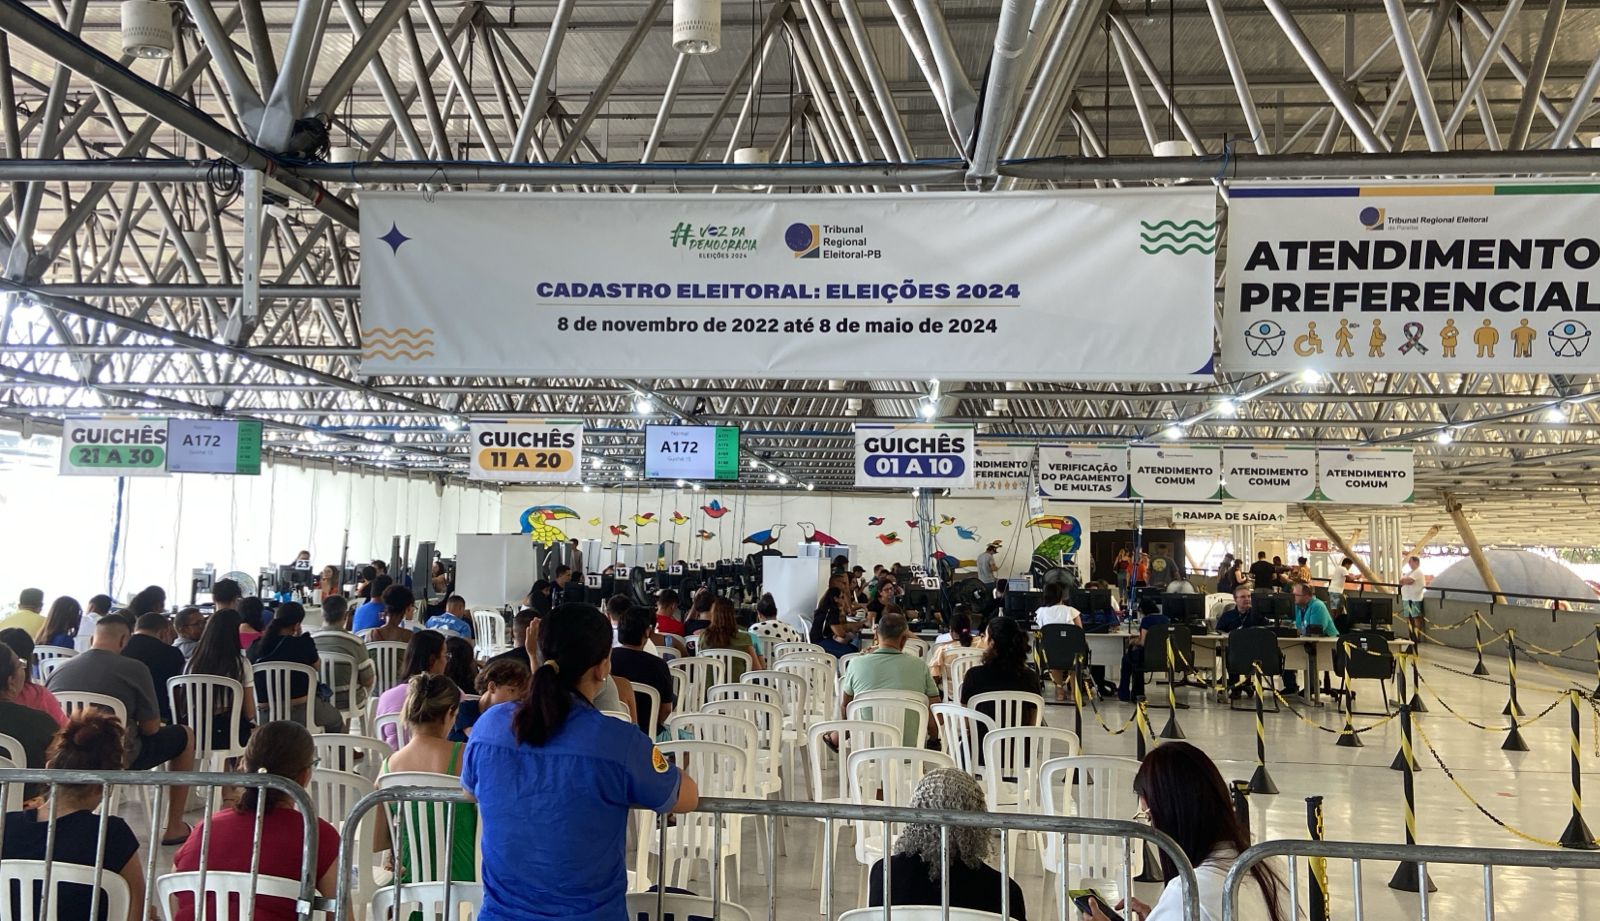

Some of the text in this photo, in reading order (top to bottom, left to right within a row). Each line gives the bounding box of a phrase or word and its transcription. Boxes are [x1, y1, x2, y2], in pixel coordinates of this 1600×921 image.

[1420, 216, 1454, 225] Regional
[731, 226, 746, 237] DA
[822, 225, 863, 234] Tribunal
[689, 239, 758, 251] DEMOCRACIA
[822, 237, 867, 249] Regional
[698, 252, 729, 260] ELEIÇÕES
[822, 250, 882, 260] Eleitoral-PB
[1244, 238, 1600, 271] ATENDIMENTO
[536, 279, 1021, 304] CADASTRO ELEITORAL: ELEIÇÕES 2024
[1240, 281, 1600, 312] PREFERENCIAL
[557, 316, 997, 333] 8 de novembro de 2022 até 8 de maio de 2024
[71, 425, 166, 445] GUICHÊS
[183, 434, 221, 447] A172
[479, 429, 575, 448] GUICHÊS
[661, 441, 698, 453] A172
[864, 433, 965, 453] GUICHÊS
[79, 448, 154, 464] 21 A 30
[491, 452, 561, 468] 11 A 20
[876, 457, 953, 474] 01 A 10
[1049, 463, 1118, 474] VERIFICAÇÃO
[1137, 466, 1213, 476] ATENDIMENTO
[1230, 467, 1308, 477] ATENDIMENTO
[1326, 469, 1406, 479] ATENDIMENTO
[1155, 477, 1196, 485] COMUM
[1248, 477, 1291, 487] COMUM
[1345, 480, 1388, 489] COMUM
[1071, 484, 1112, 492] MULTAS
[1182, 510, 1277, 521] RAMPA DE SAÍDA
[616, 568, 627, 577] 12
[588, 577, 598, 586] 11
[927, 579, 938, 588] 01
